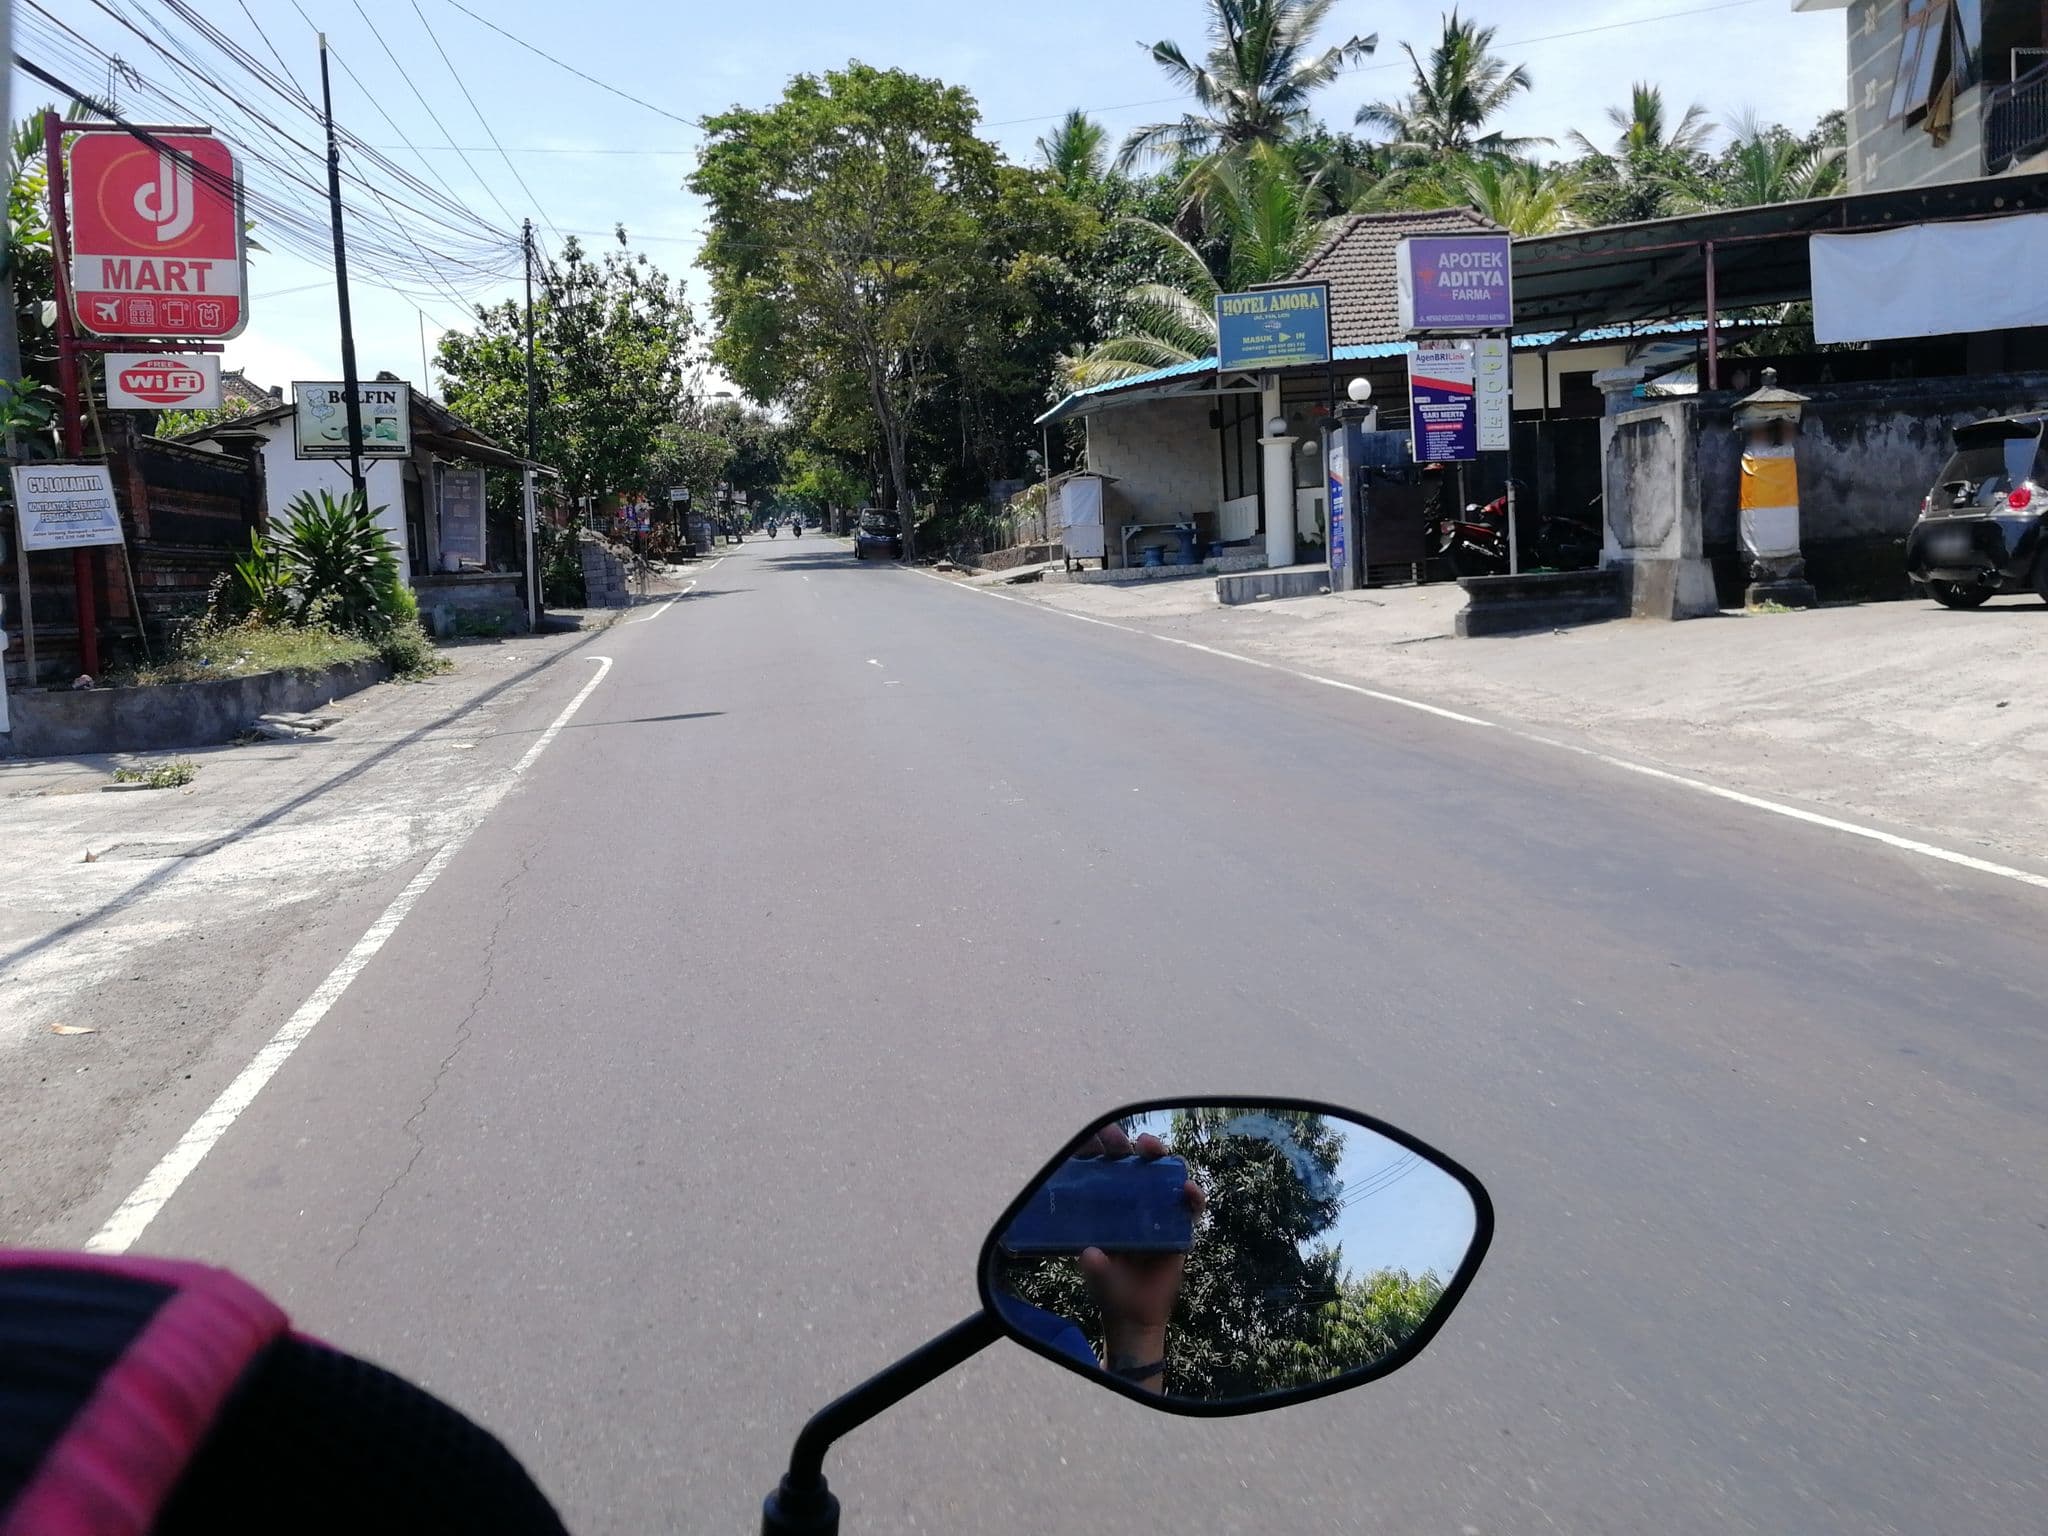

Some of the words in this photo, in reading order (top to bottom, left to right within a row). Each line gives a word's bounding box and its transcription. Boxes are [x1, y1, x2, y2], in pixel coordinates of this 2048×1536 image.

[1438, 252, 1503, 268] APOTEK
[102, 259, 213, 293] MART
[1438, 270, 1504, 288] ADITYA
[1222, 297, 1268, 316] HOTEL
[1270, 291, 1320, 311] AMORA
[1451, 289, 1491, 301] FARMA
[147, 360, 174, 369] FREE
[28, 477, 48, 493] CV.
[48, 476, 103, 492] LOKAHITA
